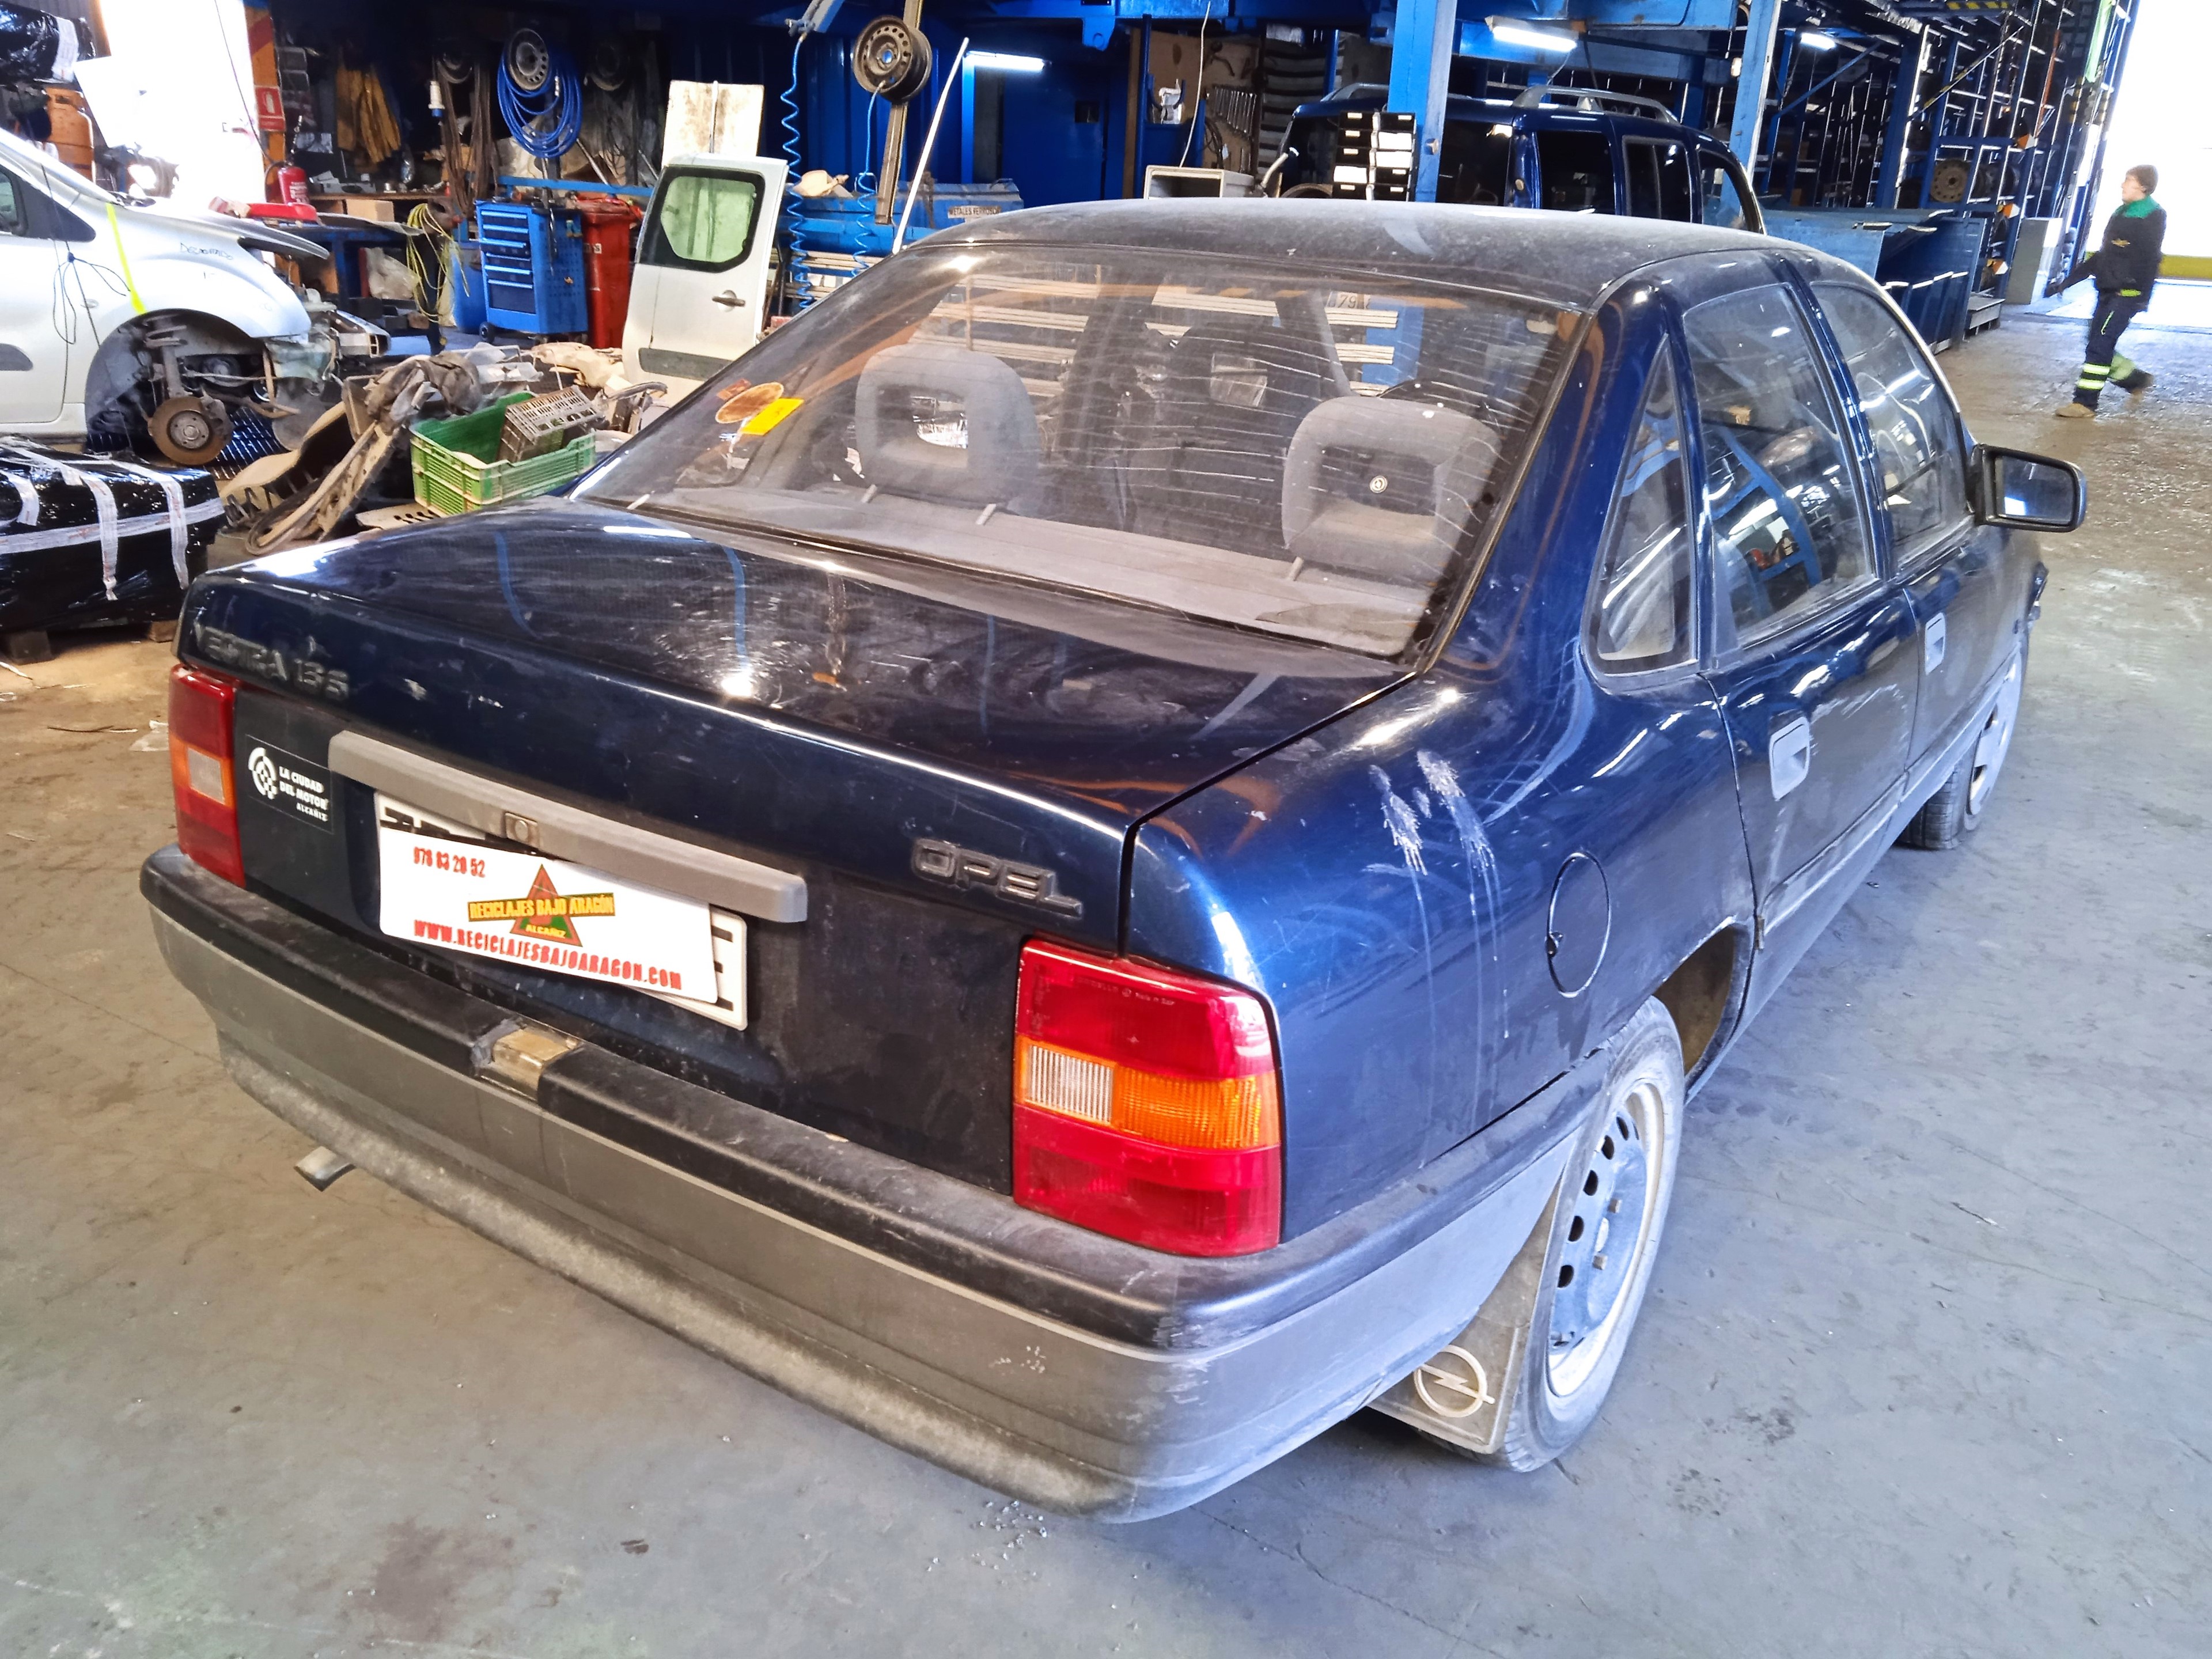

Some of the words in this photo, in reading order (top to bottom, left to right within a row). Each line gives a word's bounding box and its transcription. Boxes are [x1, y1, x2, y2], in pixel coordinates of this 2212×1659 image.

[279, 766, 290, 780] LA
[291, 772, 324, 793] CIUDAD
[279, 781, 296, 797] DEL
[296, 788, 329, 810] MOTOR
[471, 858, 485, 878] 52
[911, 838, 1082, 920] OPEL
[469, 900, 535, 919] RECICLAJES
[536, 898, 567, 916] BAJO
[569, 895, 614, 915] ARAGÓN
[414, 919, 682, 990] WWW.RECICLAJESBAJOARAGON.COM
